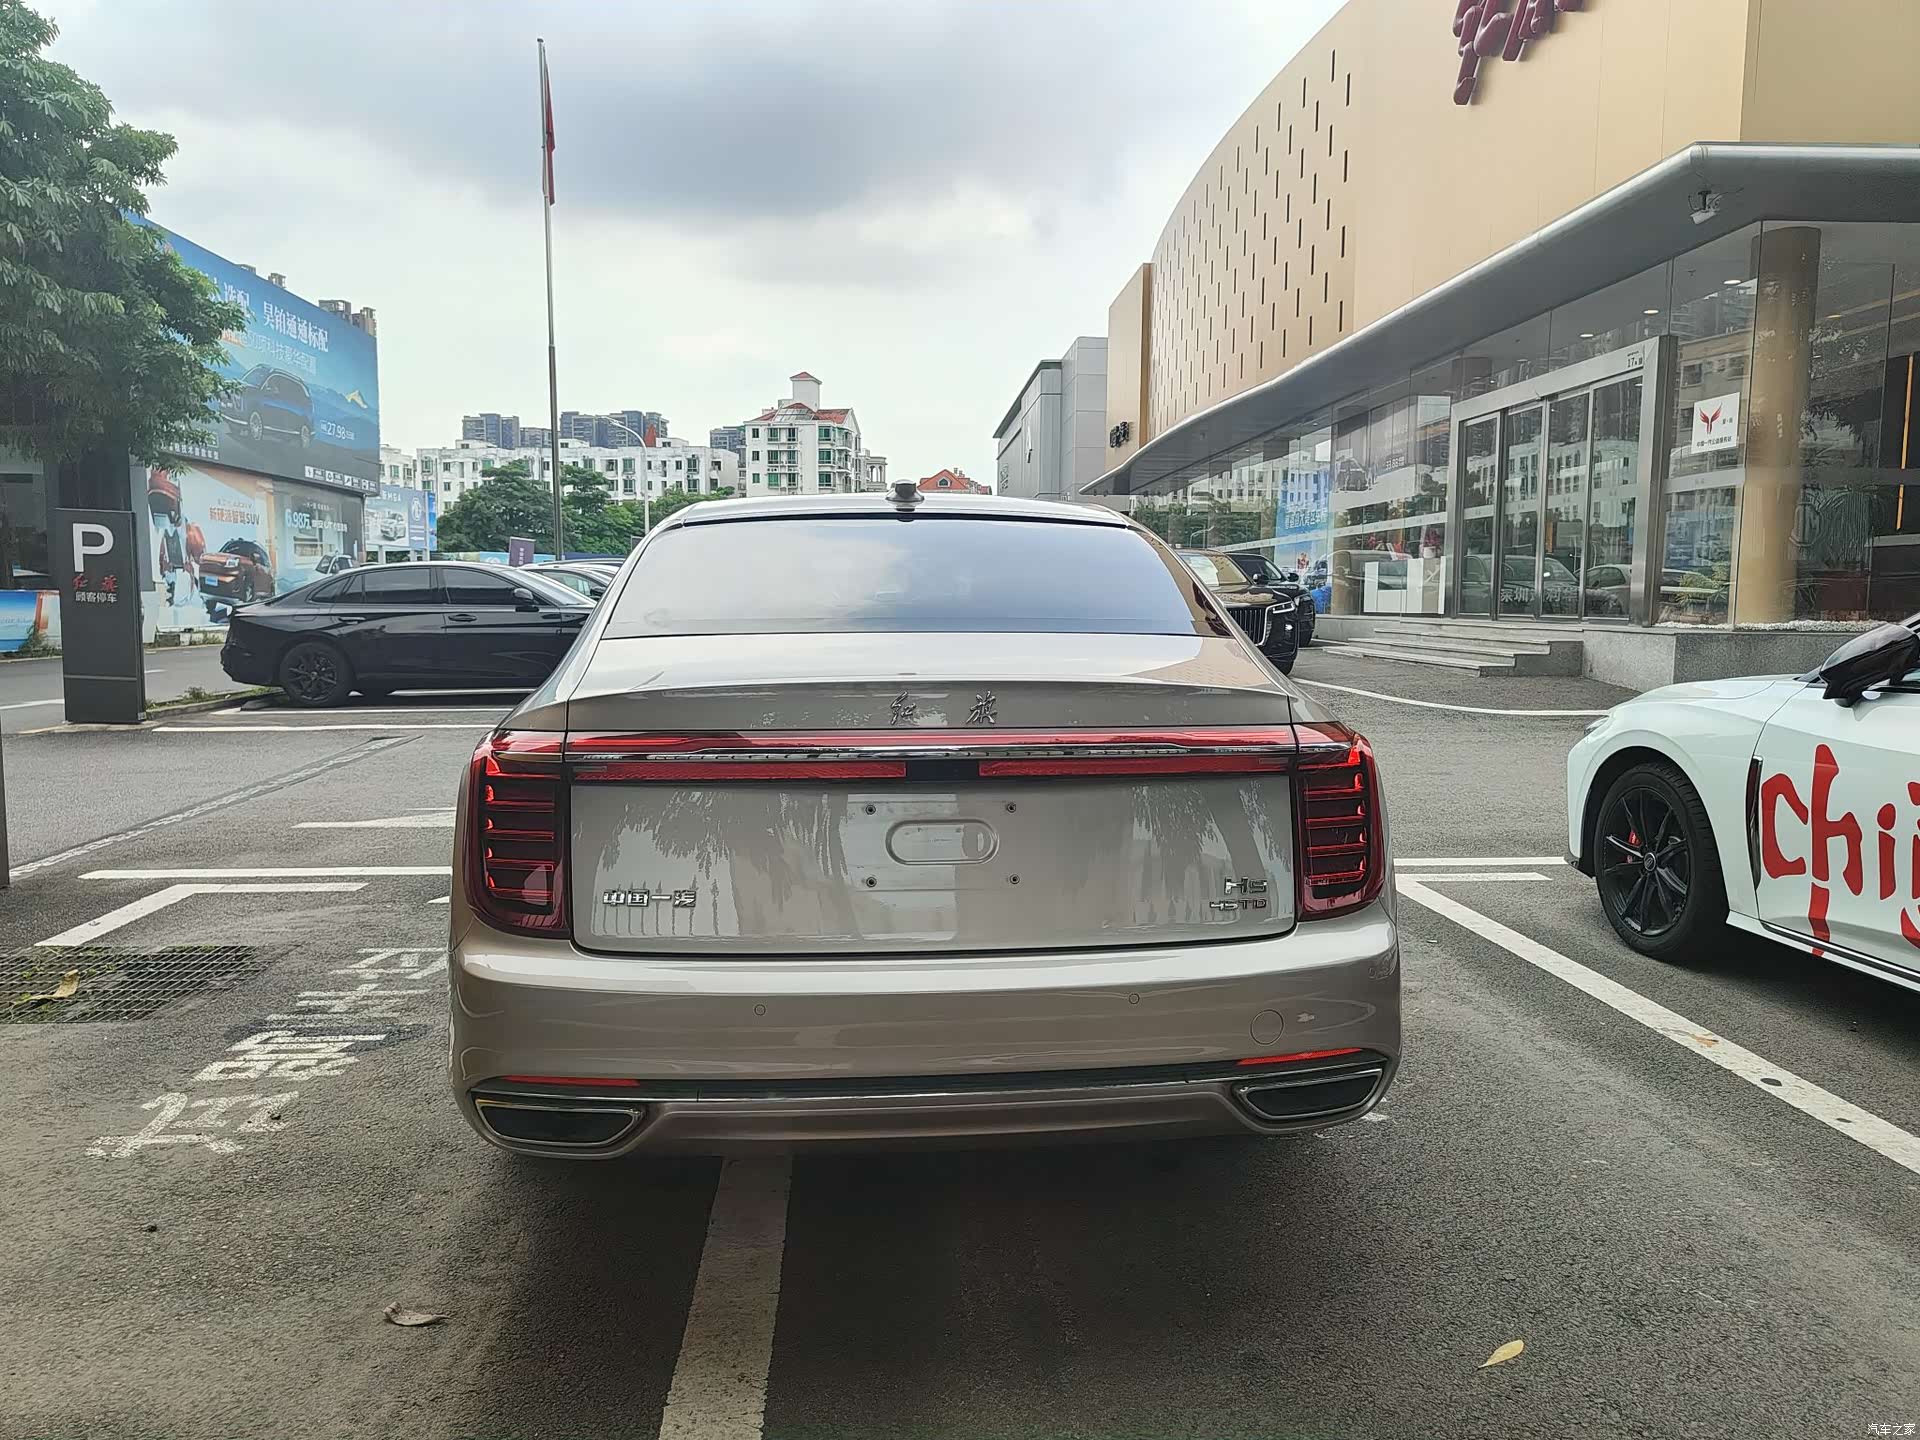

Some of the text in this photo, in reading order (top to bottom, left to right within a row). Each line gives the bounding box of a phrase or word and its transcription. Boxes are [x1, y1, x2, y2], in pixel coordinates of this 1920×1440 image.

[72, 523, 114, 573] P
[75, 591, 118, 603] 顾客停车
[602, 888, 698, 909] 中国一汽
